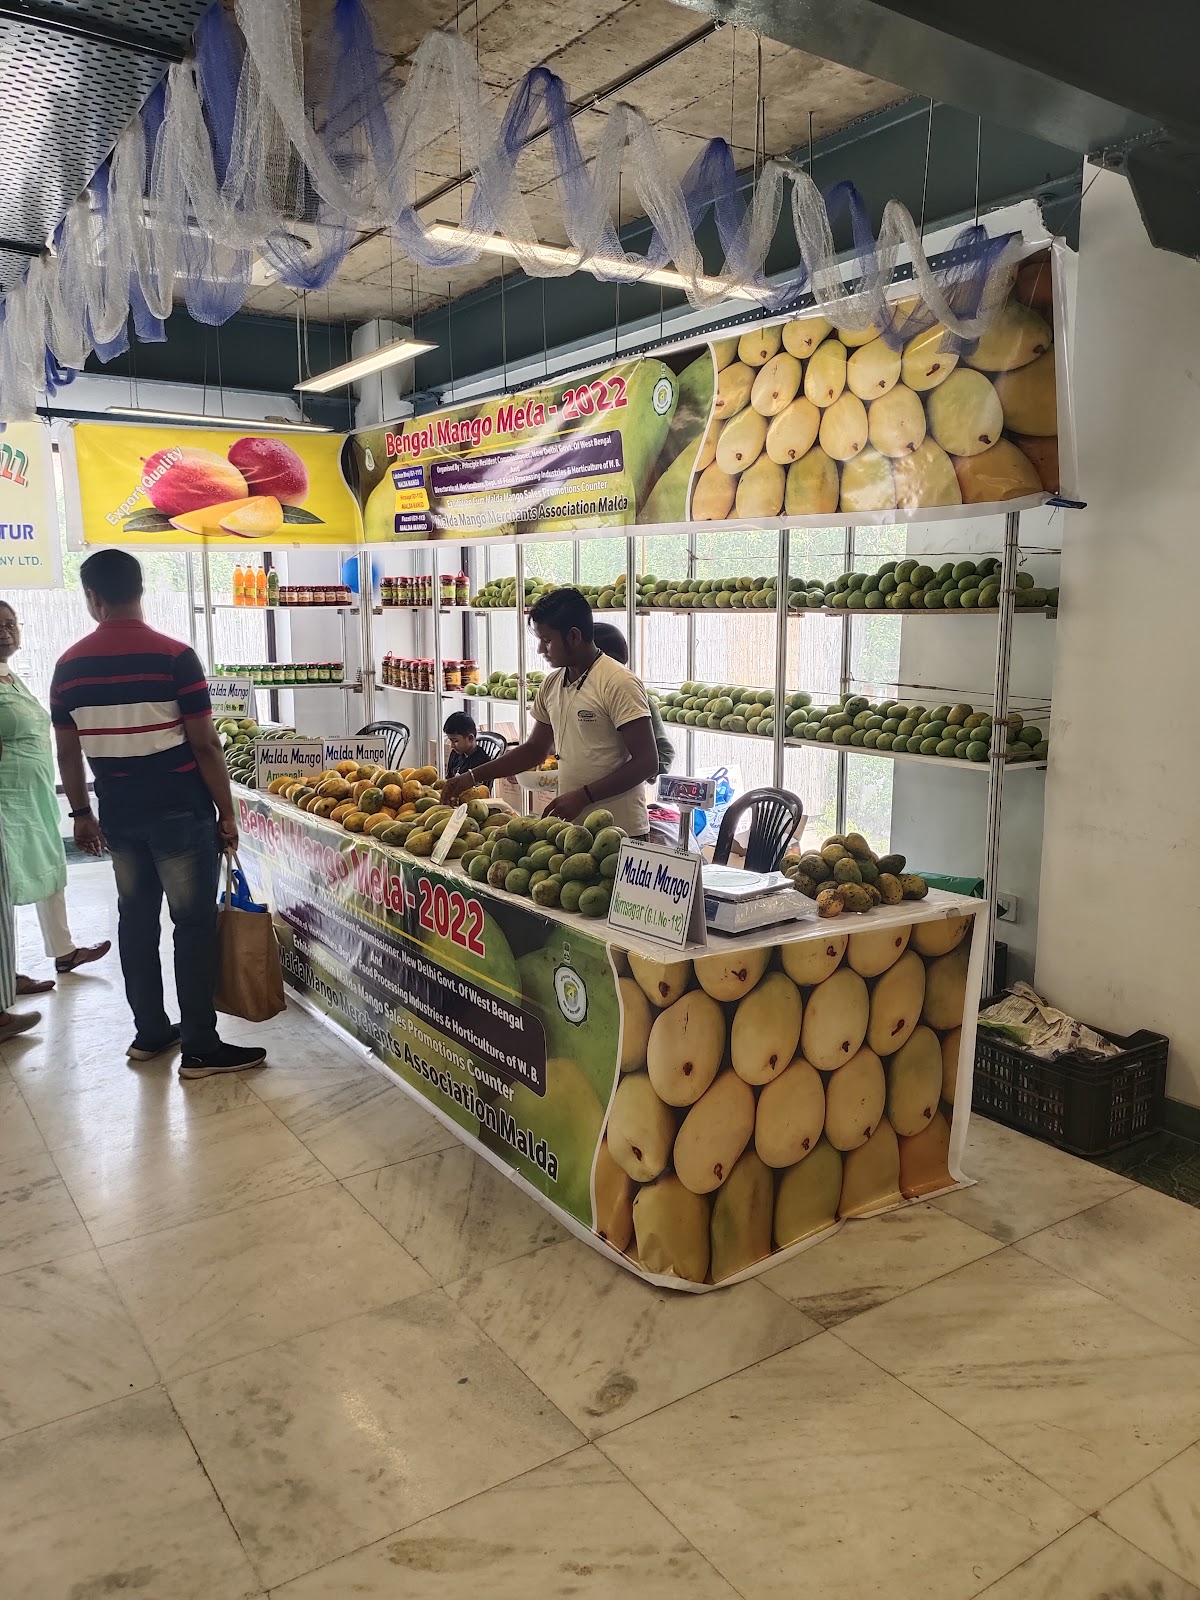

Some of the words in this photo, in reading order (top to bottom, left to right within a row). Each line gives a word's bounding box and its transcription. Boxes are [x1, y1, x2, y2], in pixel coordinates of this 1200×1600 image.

[385, 423, 435, 457] Bengal
[436, 418, 493, 446] Mango
[496, 400, 546, 433] Mela
[548, 404, 558, 415] -
[562, 376, 629, 420] 2022
[593, 435, 612, 446] Bengal
[0, 442, 28, 488] 22
[105, 485, 147, 526] Export
[140, 445, 183, 489] Quality
[485, 492, 503, 504] Malda
[503, 491, 524, 503] Mango
[523, 488, 542, 500] Sales
[542, 484, 580, 498] Promotions
[581, 480, 608, 492] Counter
[459, 512, 488, 529] Mango
[487, 506, 539, 526] Merchants
[538, 501, 596, 519] Association
[598, 494, 628, 513] Malda
[18, 556, 43, 566] LTD.
[211, 703, 224, 712] ngra
[227, 683, 249, 700] Mango
[260, 748, 289, 765] Malda
[290, 747, 321, 768] Mango
[325, 745, 354, 761] Malda
[355, 744, 385, 763] Mango
[239, 798, 290, 857] Bengal
[289, 819, 350, 891] Mango
[350, 848, 405, 916] Mela
[418, 877, 486, 959] 2022
[619, 855, 653, 890] Malda
[653, 864, 690, 905] Mango
[356, 924, 402, 962] Commissioner,
[401, 949, 417, 970] New
[417, 958, 437, 981] Delhi
[437, 970, 458, 994] Govt.
[458, 982, 469, 999] Of
[468, 988, 491, 1013] West
[491, 999, 525, 1032] Bengal
[370, 949, 383, 968] And
[336, 967, 357, 993] Malda
[357, 983, 384, 1014] Mango
[383, 1001, 407, 1031] Sales
[407, 1018, 466, 1071] Promotions
[466, 1058, 515, 1102] Counter
[358, 959, 374, 978] Food
[373, 968, 409, 1004] Processing
[408, 990, 444, 1025] Industries
[444, 1015, 452, 1030] &
[451, 1018, 505, 1062] Horticulture
[505, 1054, 517, 1070] of
[517, 1057, 530, 1078] W.
[530, 1065, 540, 1085] B.
[305, 962, 340, 1008] Mango
[339, 990, 402, 1059] Merchants
[403, 1040, 498, 1133] Association
[499, 1107, 559, 1184] Malda
